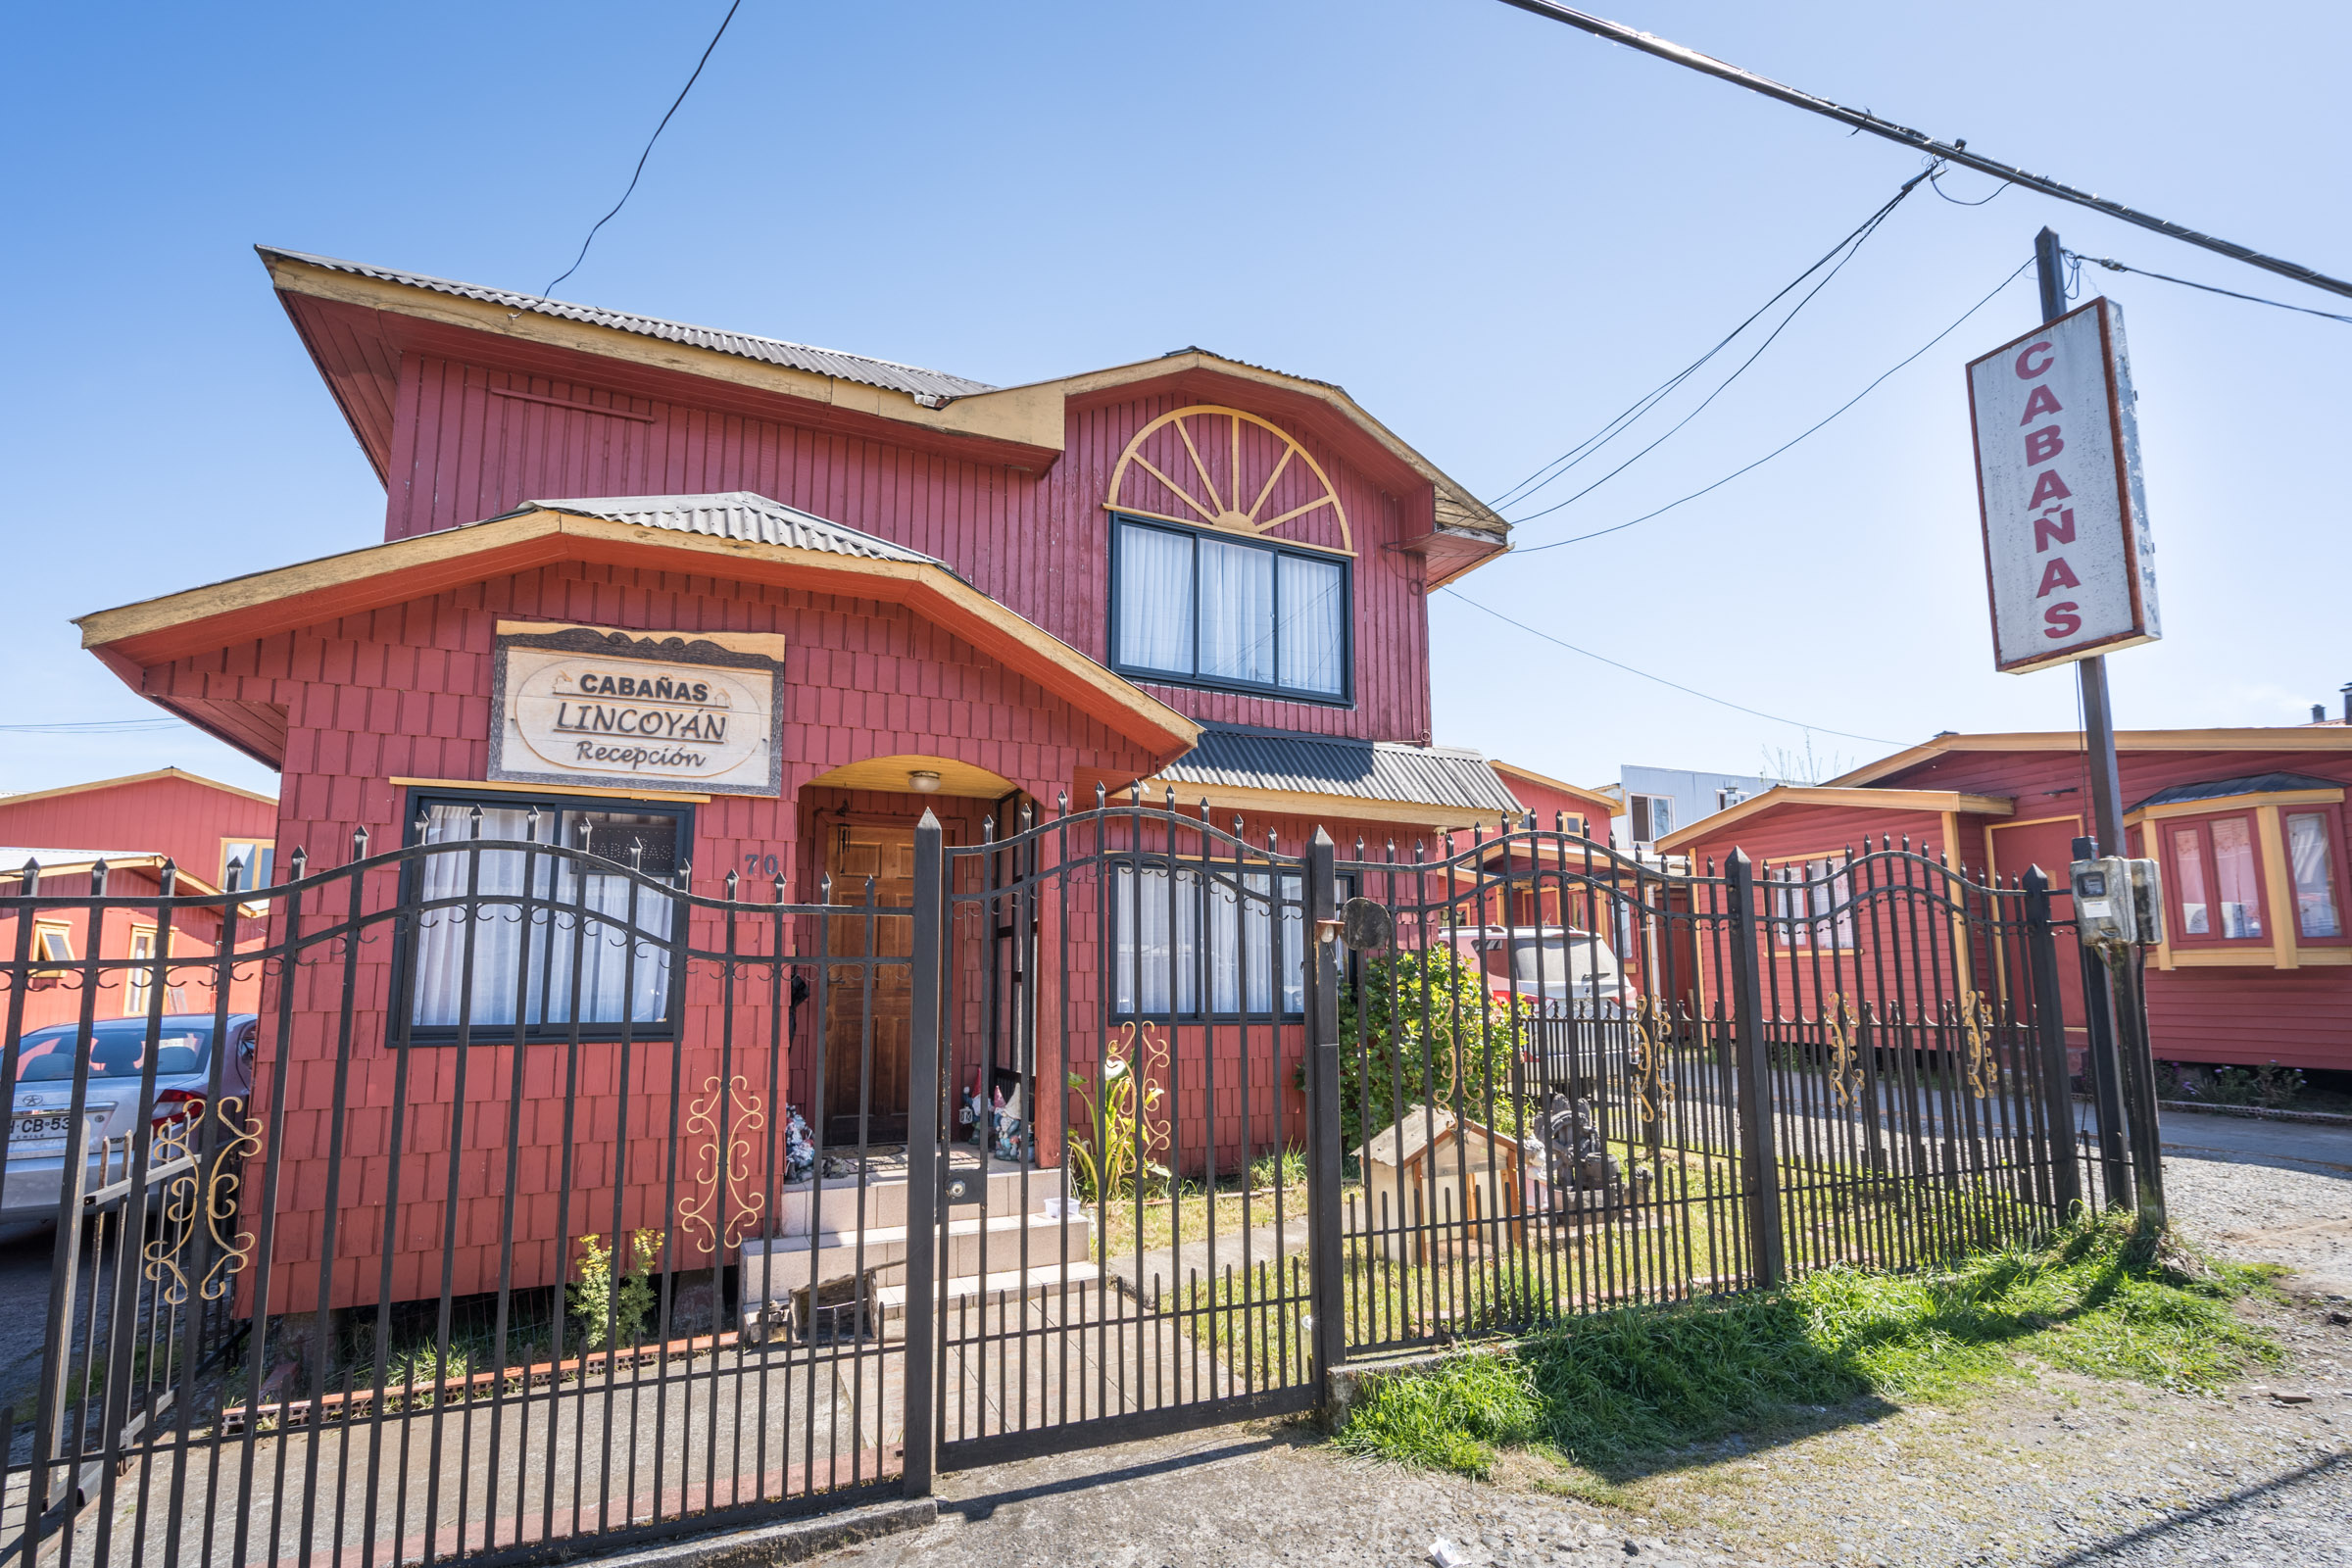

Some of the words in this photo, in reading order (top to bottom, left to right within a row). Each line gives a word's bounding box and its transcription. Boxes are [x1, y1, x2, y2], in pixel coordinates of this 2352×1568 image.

[2015, 340, 2082, 640] CABAÑAS
[579, 673, 709, 703] CABAÑAS
[557, 702, 726, 741] LINCOYÁN
[576, 740, 707, 770] Recepción
[745, 854, 778, 875] 70
